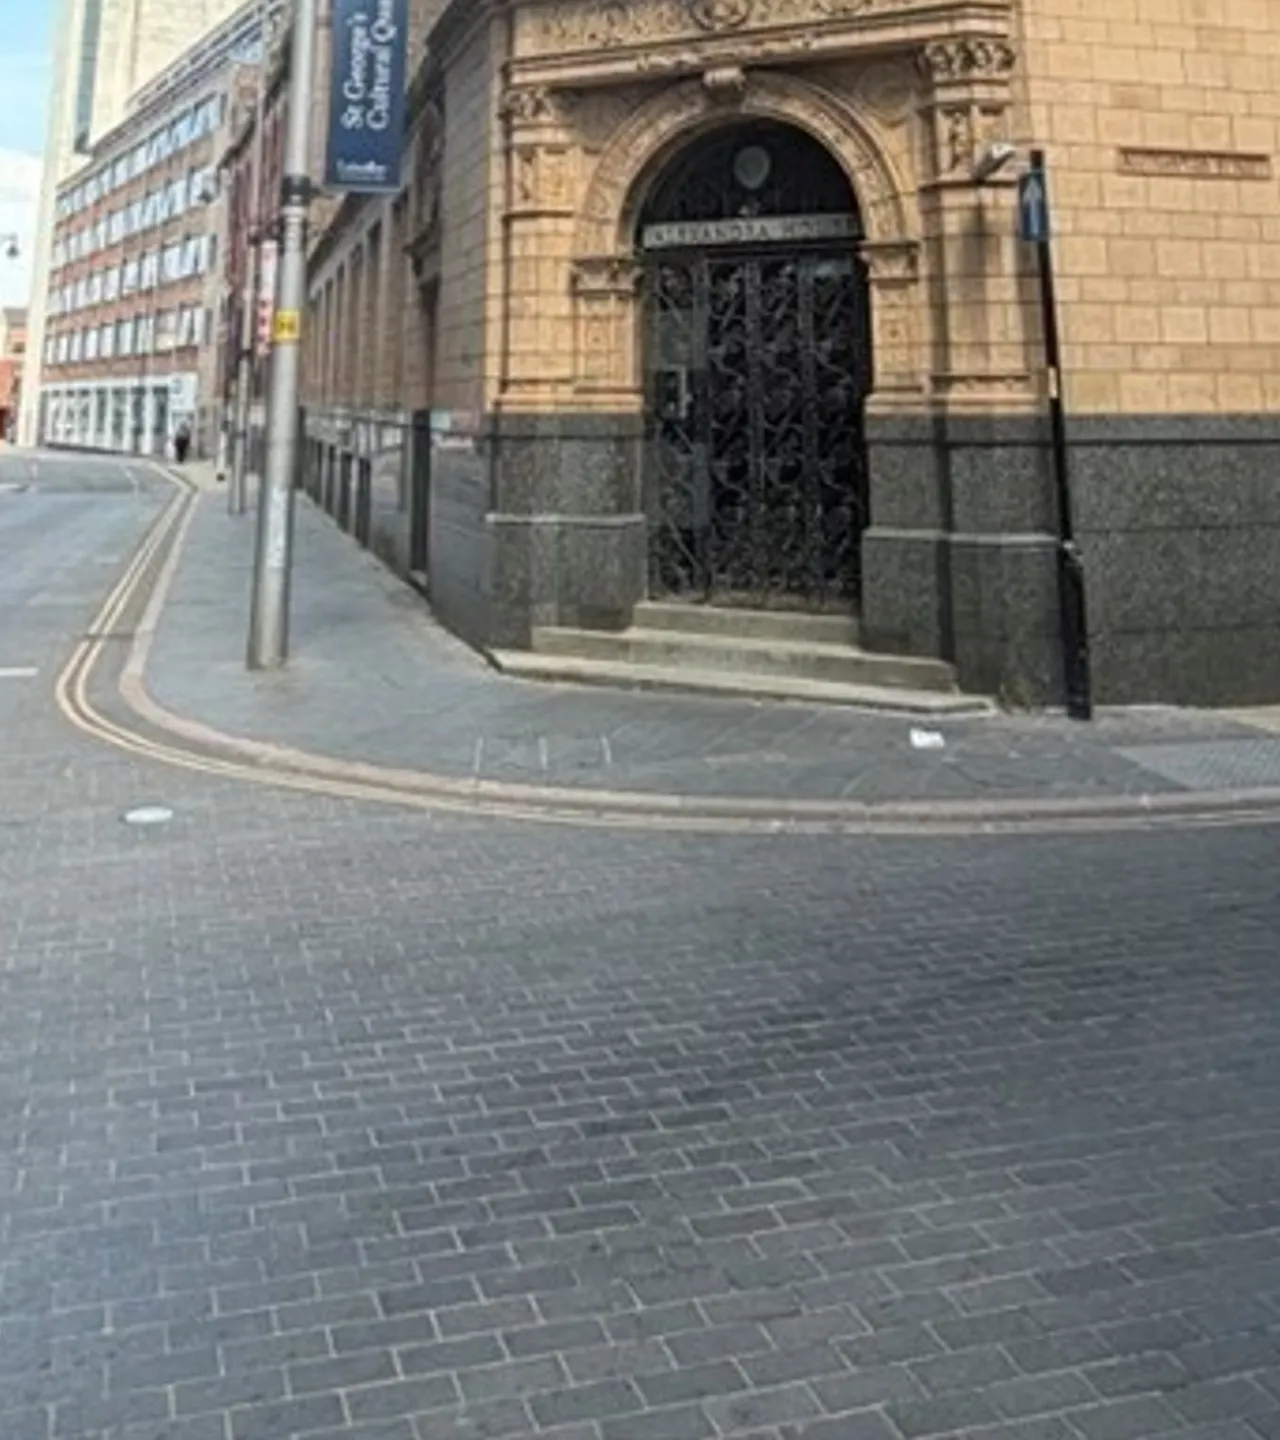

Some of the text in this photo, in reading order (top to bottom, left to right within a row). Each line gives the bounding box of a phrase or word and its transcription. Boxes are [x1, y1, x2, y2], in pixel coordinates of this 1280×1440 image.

[343, 12, 370, 100] George's
[366, 44, 391, 130] Cultural
[340, 106, 365, 129] St
